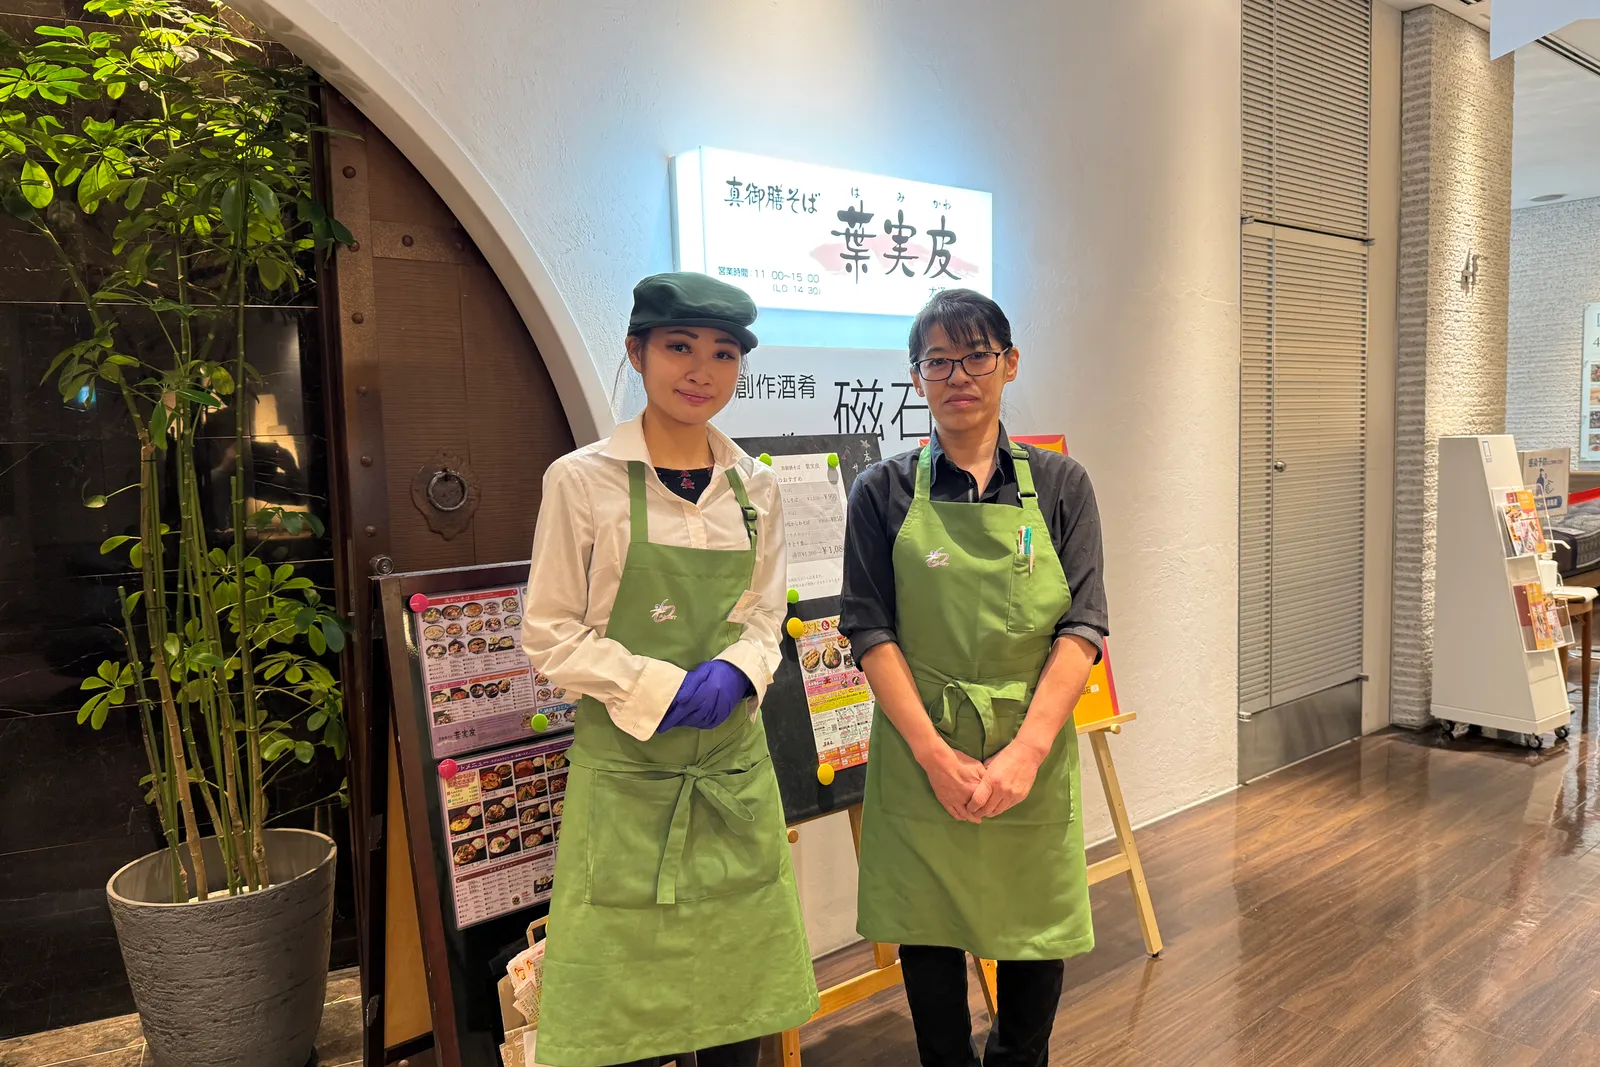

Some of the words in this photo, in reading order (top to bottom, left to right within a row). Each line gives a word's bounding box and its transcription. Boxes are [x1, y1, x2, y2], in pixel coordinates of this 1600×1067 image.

[724, 176, 820, 214] 真御膳そば
[831, 200, 962, 284] 葉実皮
[735, 374, 817, 399] 創作酒肴
[833, 379, 932, 441] 磁石
